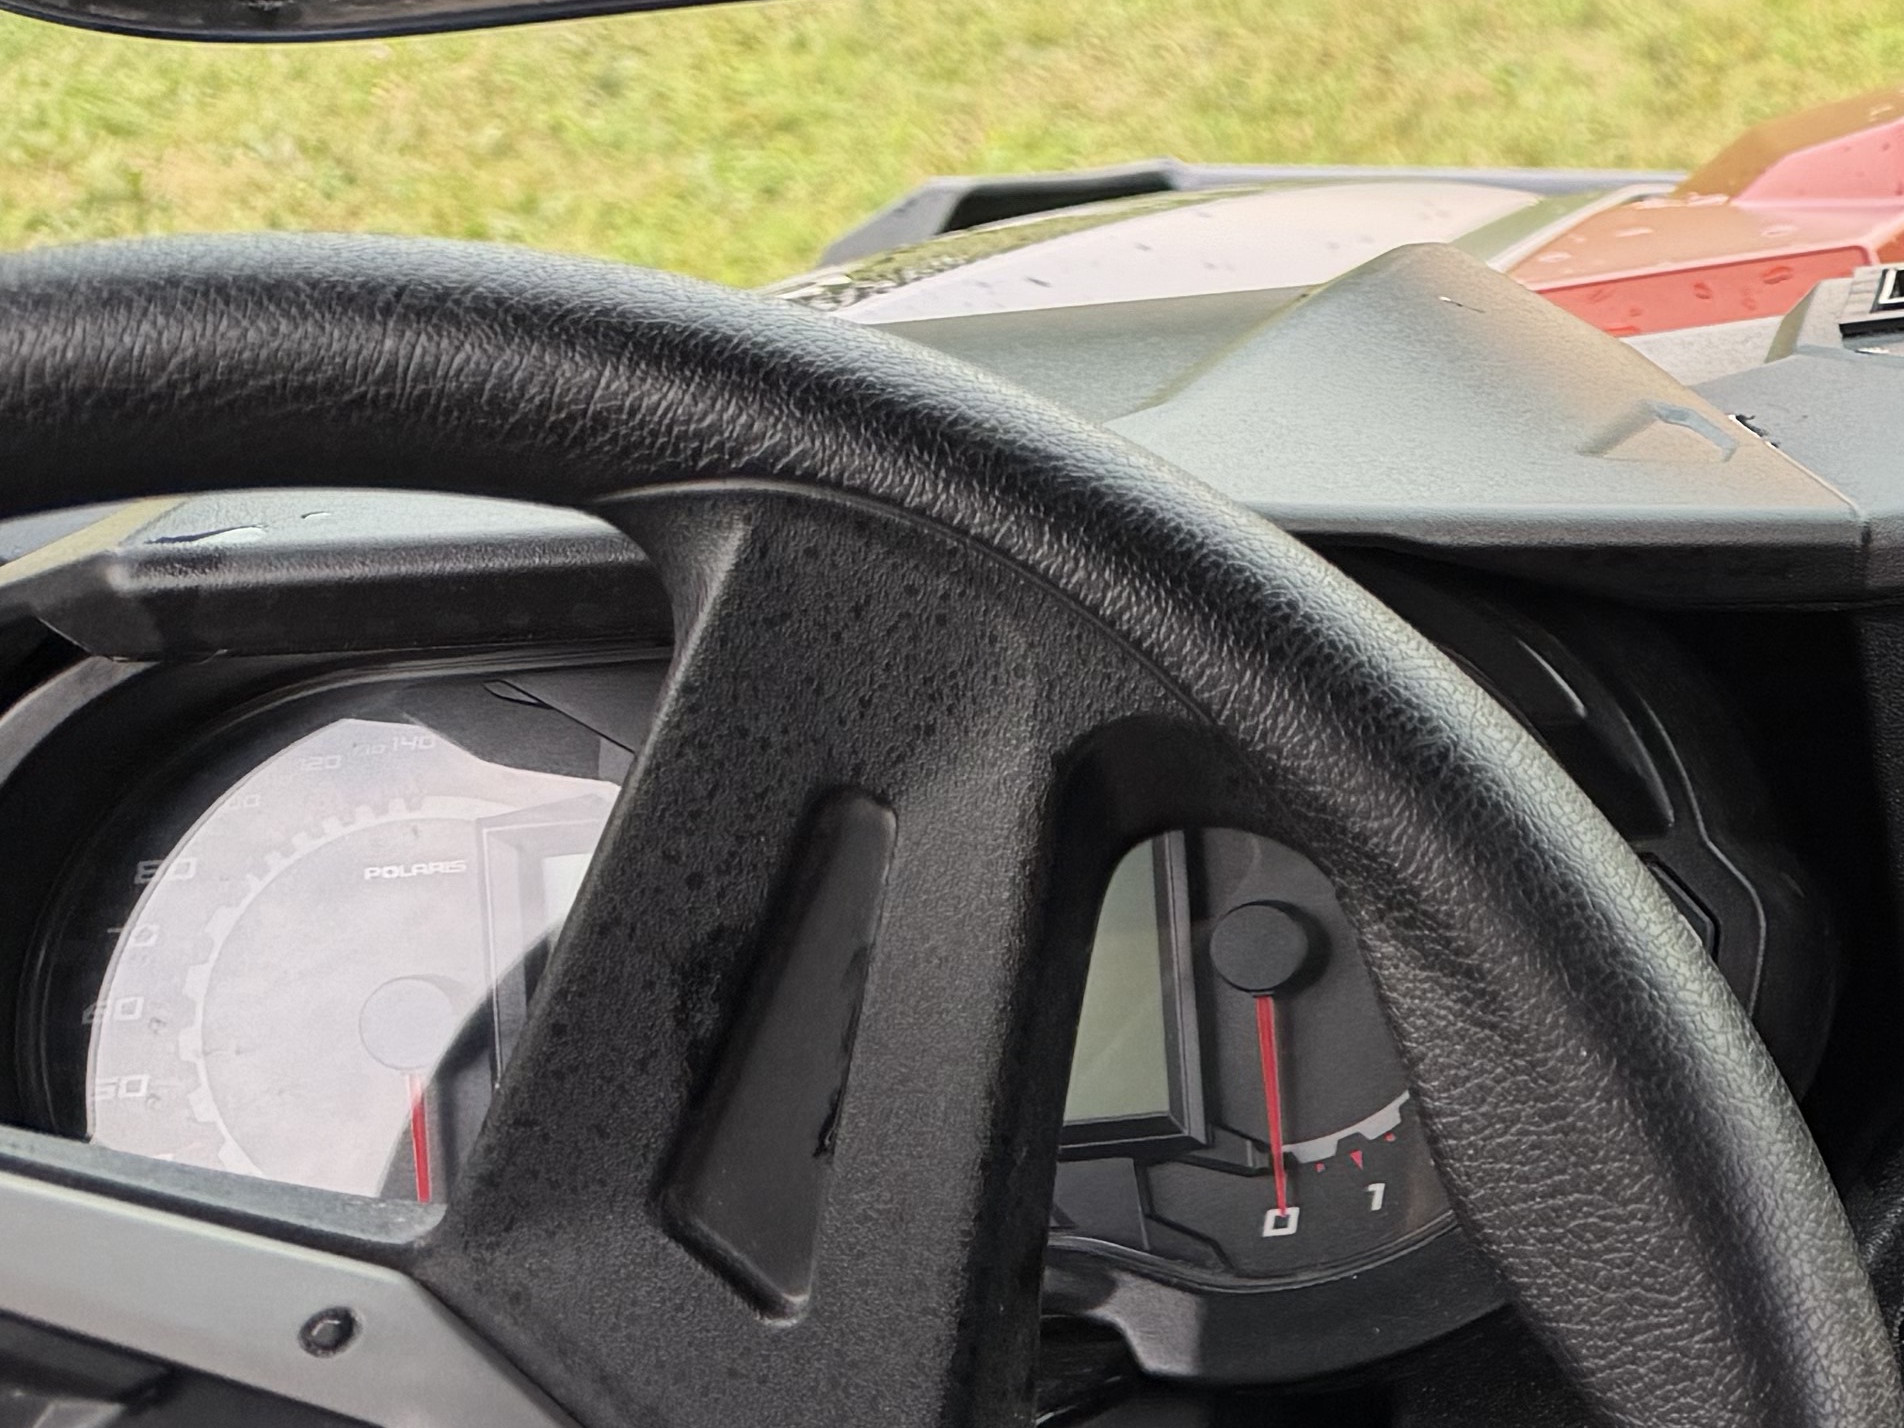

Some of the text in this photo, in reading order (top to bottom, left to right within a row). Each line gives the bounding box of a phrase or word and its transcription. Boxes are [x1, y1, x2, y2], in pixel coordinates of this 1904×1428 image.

[364, 859, 467, 880] POLARIS
[1366, 1183, 1386, 1211] 1
[1262, 1206, 1300, 1238] 0
